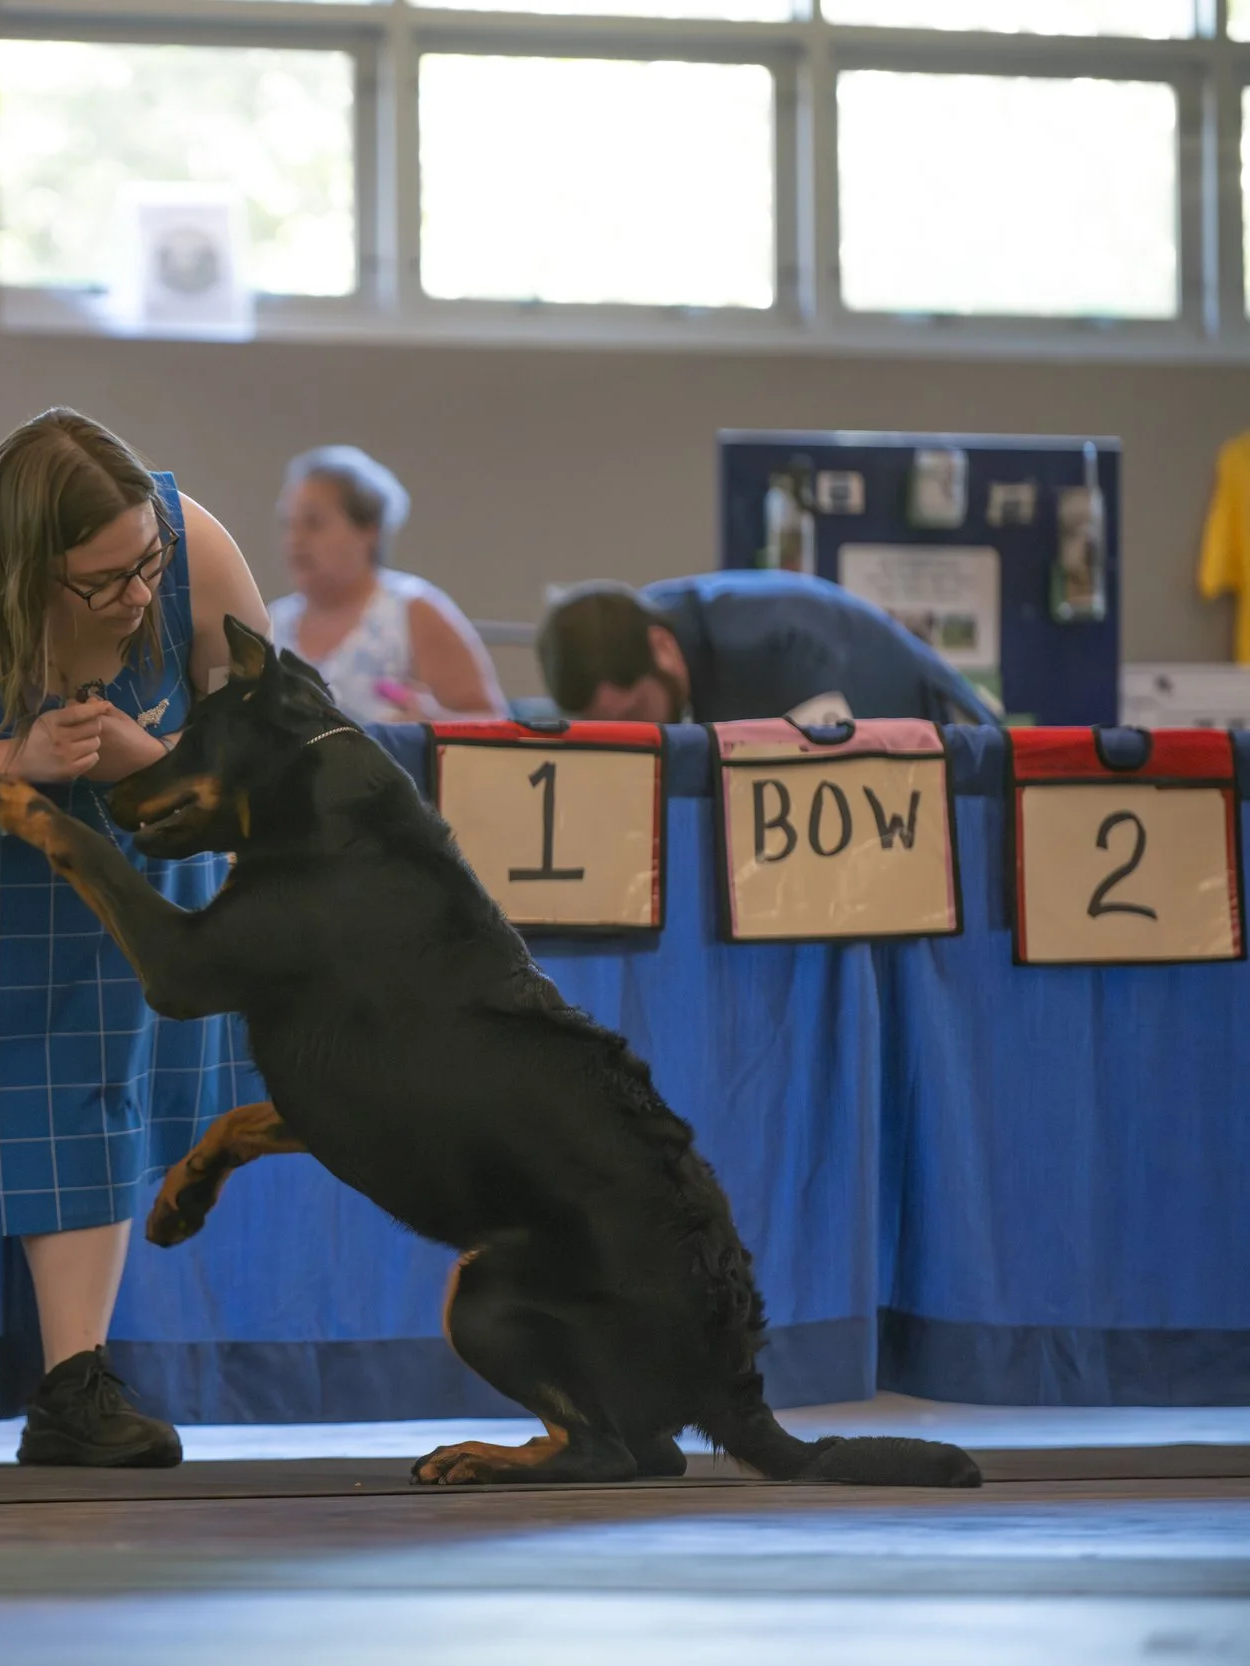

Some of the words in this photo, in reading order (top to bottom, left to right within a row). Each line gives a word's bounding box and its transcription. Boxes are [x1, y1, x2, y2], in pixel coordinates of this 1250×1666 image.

[508, 761, 586, 883] 1
[751, 778, 921, 864] BOW
[1086, 810, 1158, 921] 2
